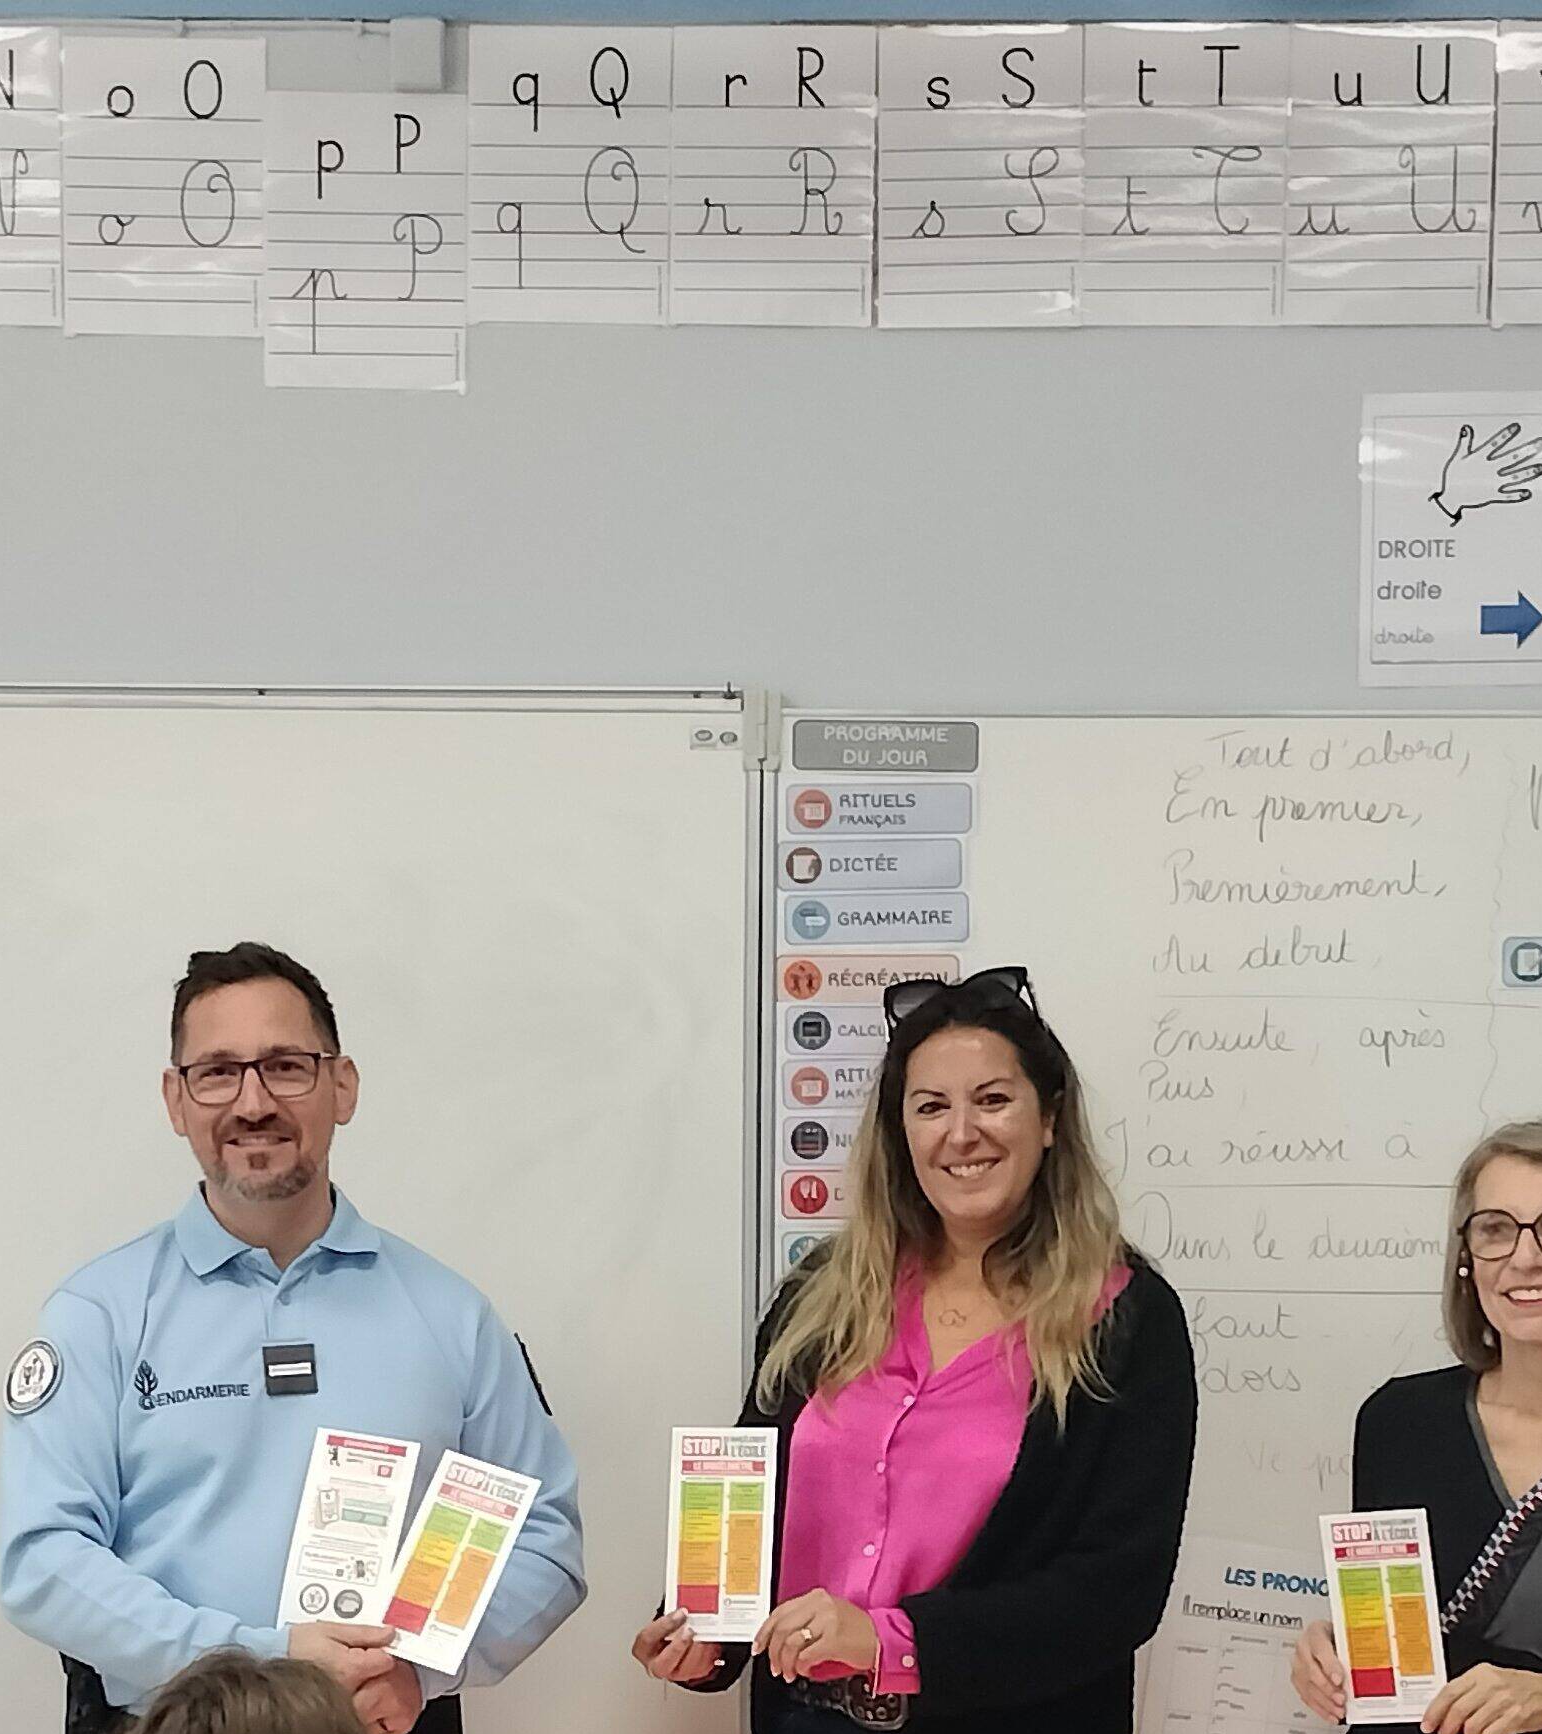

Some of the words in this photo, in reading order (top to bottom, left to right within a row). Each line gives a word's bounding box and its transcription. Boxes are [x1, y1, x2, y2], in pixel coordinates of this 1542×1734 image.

[1378, 539, 1456, 559] DROITE
[1377, 578, 1442, 601] droite
[1374, 628, 1435, 645] droite
[824, 725, 948, 743] PROGRAMME
[843, 749, 870, 765] DU
[876, 750, 928, 766] JOUR
[1205, 729, 1294, 769] Tout
[1310, 729, 1471, 778] d'abord,
[840, 793, 916, 809] RITUELS
[1166, 765, 1237, 824] En
[1258, 792, 1422, 843] premier,
[839, 814, 906, 827] FRANÇAIS
[829, 853, 898, 872] DICTÉE
[1163, 849, 1448, 905] Premièrement,
[837, 910, 952, 927] GRAMMAIRE
[1153, 934, 1212, 974] Au
[1359, 1008, 1445, 1067] après
[1105, 1118, 1192, 1187] J'ai
[1385, 1121, 1420, 1159] à
[1132, 1191, 1230, 1260] Dans
[1252, 1206, 1283, 1260] le
[1190, 1296, 1298, 1368] faut
[138, 1384, 250, 1410] GENDARMERIE
[683, 1438, 720, 1456] STOP
[448, 1462, 484, 1488] STOP
[1333, 1523, 1371, 1541] STOP
[1225, 1567, 1256, 1587] LES
[1192, 1601, 1251, 1620] remplace
[1254, 1611, 1271, 1624] un
[1274, 1614, 1303, 1628] nom
